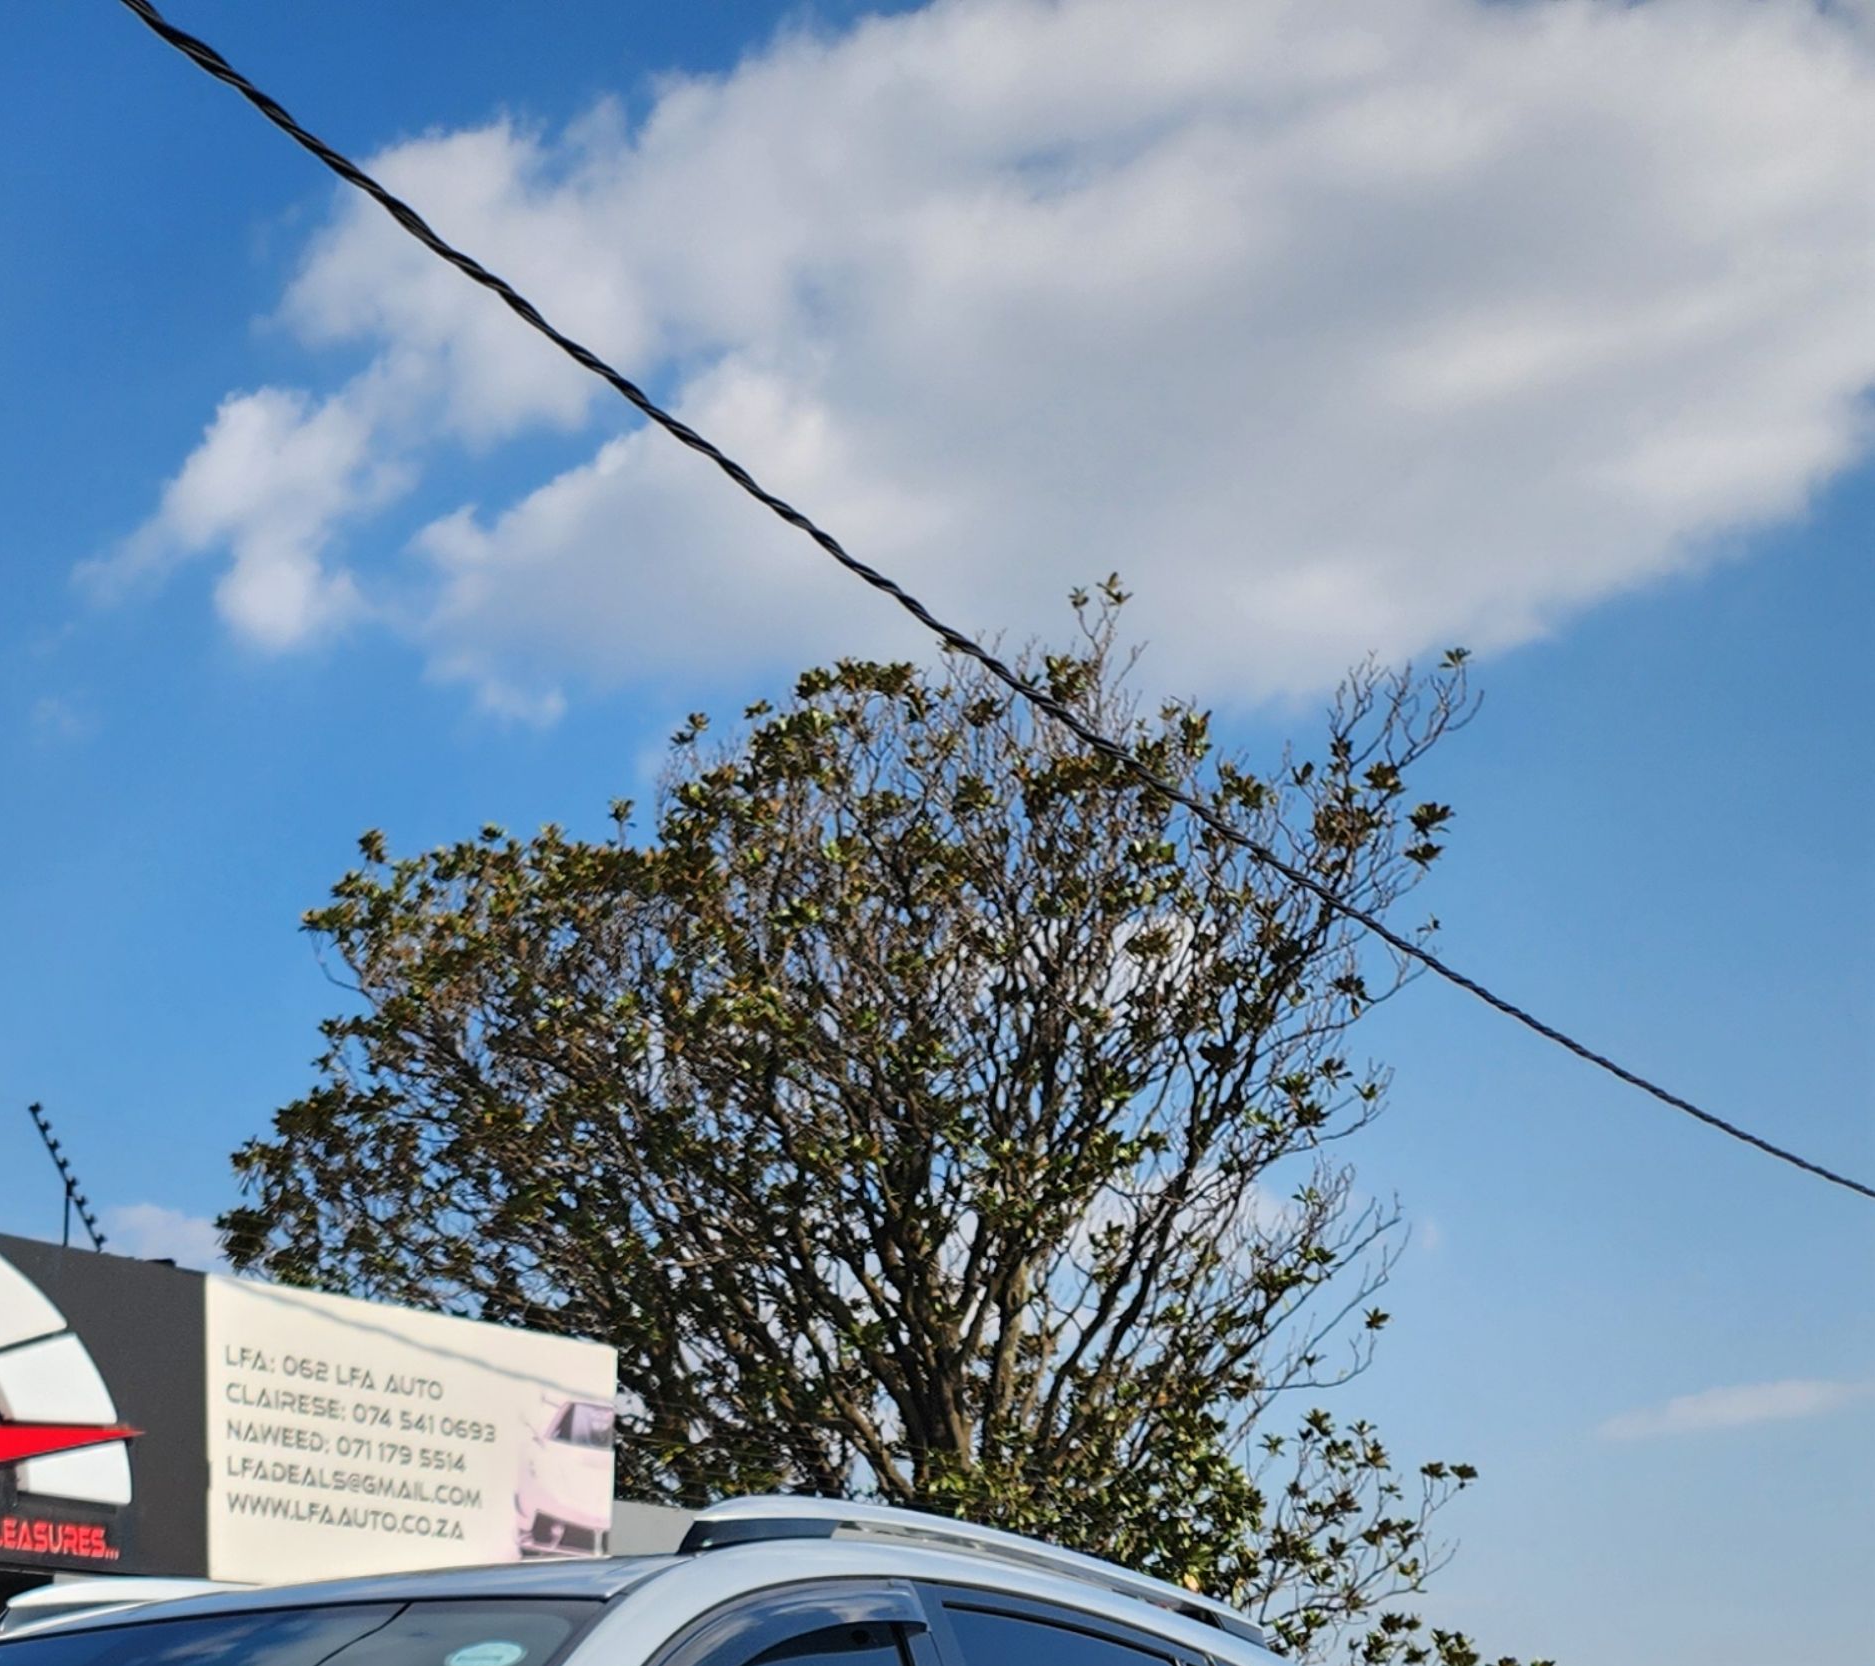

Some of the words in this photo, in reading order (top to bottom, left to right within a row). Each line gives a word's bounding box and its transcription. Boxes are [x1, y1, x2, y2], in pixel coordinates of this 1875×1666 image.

[227, 1347, 275, 1373] LFA:
[283, 1355, 329, 1382] 062
[336, 1365, 376, 1390] LFA
[384, 1374, 443, 1401] AUTO
[227, 1383, 345, 1420] CLAIRESE:
[353, 1403, 392, 1427] 074
[400, 1410, 434, 1434] 541
[440, 1417, 496, 1443] 0693
[228, 1421, 329, 1454] NAWEED:
[337, 1436, 371, 1460] 071
[378, 1442, 412, 1465] 179
[420, 1448, 466, 1472] 5514
[228, 1457, 482, 1508] LFADEALS@GMAIL.COM
[229, 1493, 464, 1539] WWW.LFAAUTO.CO.ZA
